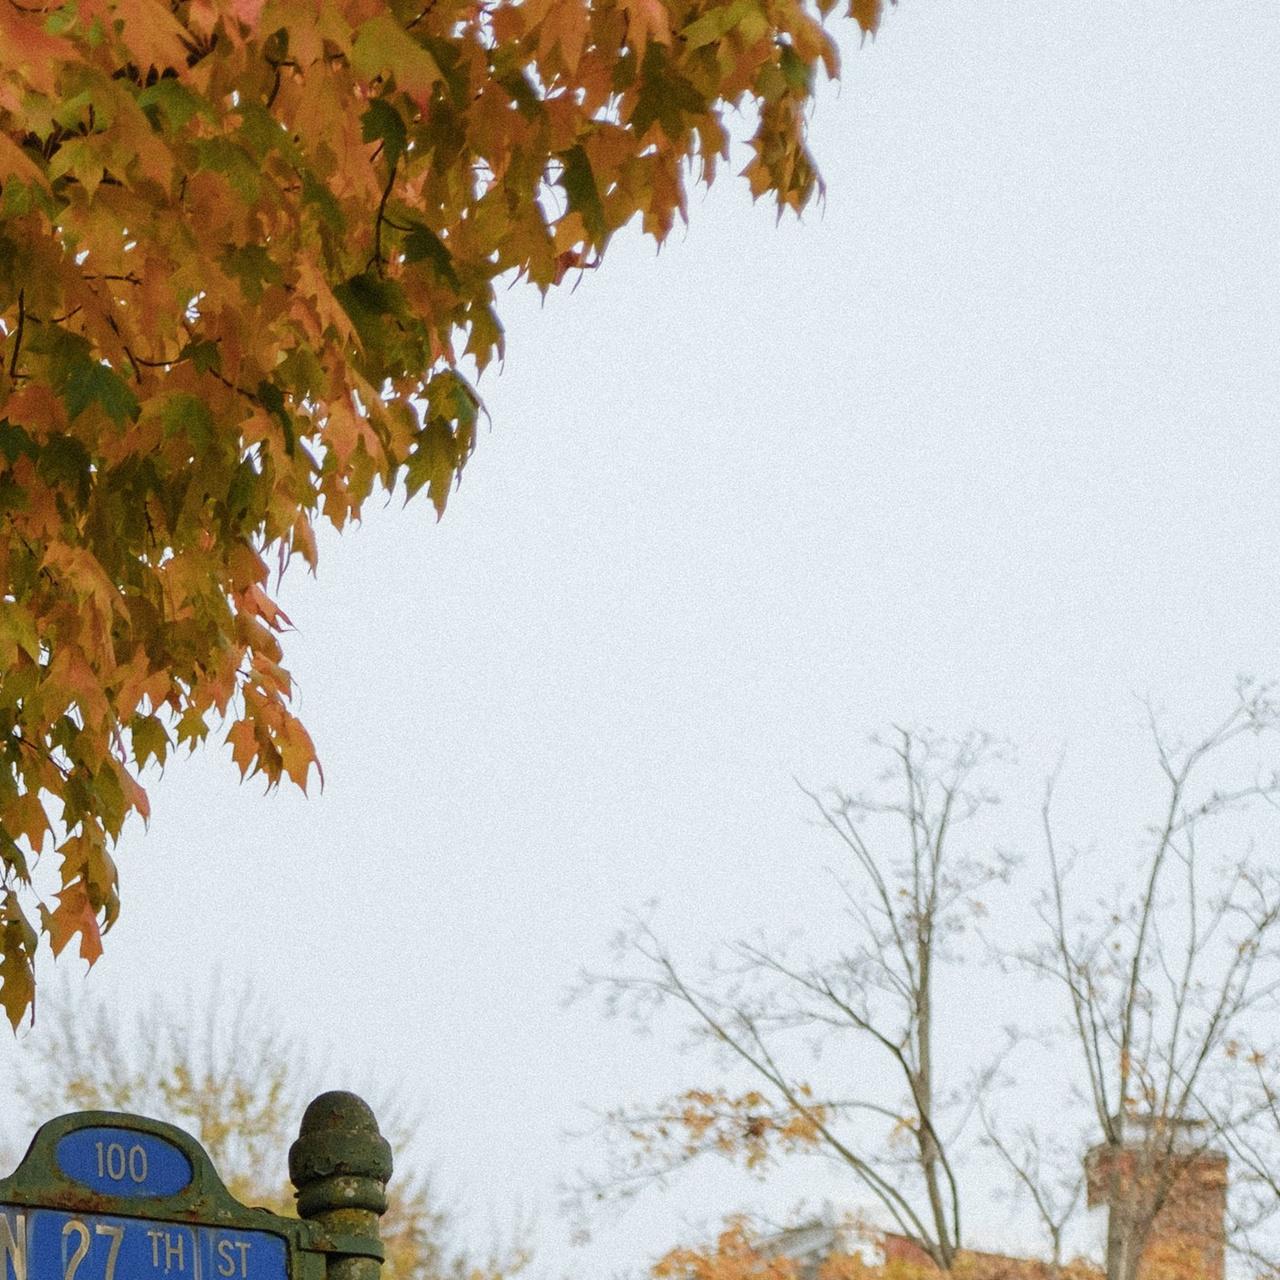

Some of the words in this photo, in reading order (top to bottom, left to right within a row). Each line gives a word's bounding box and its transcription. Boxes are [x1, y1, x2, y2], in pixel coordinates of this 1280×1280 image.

[95, 1142, 148, 1183] 100
[147, 1231, 185, 1272] TH
[217, 1239, 252, 1279] ST
